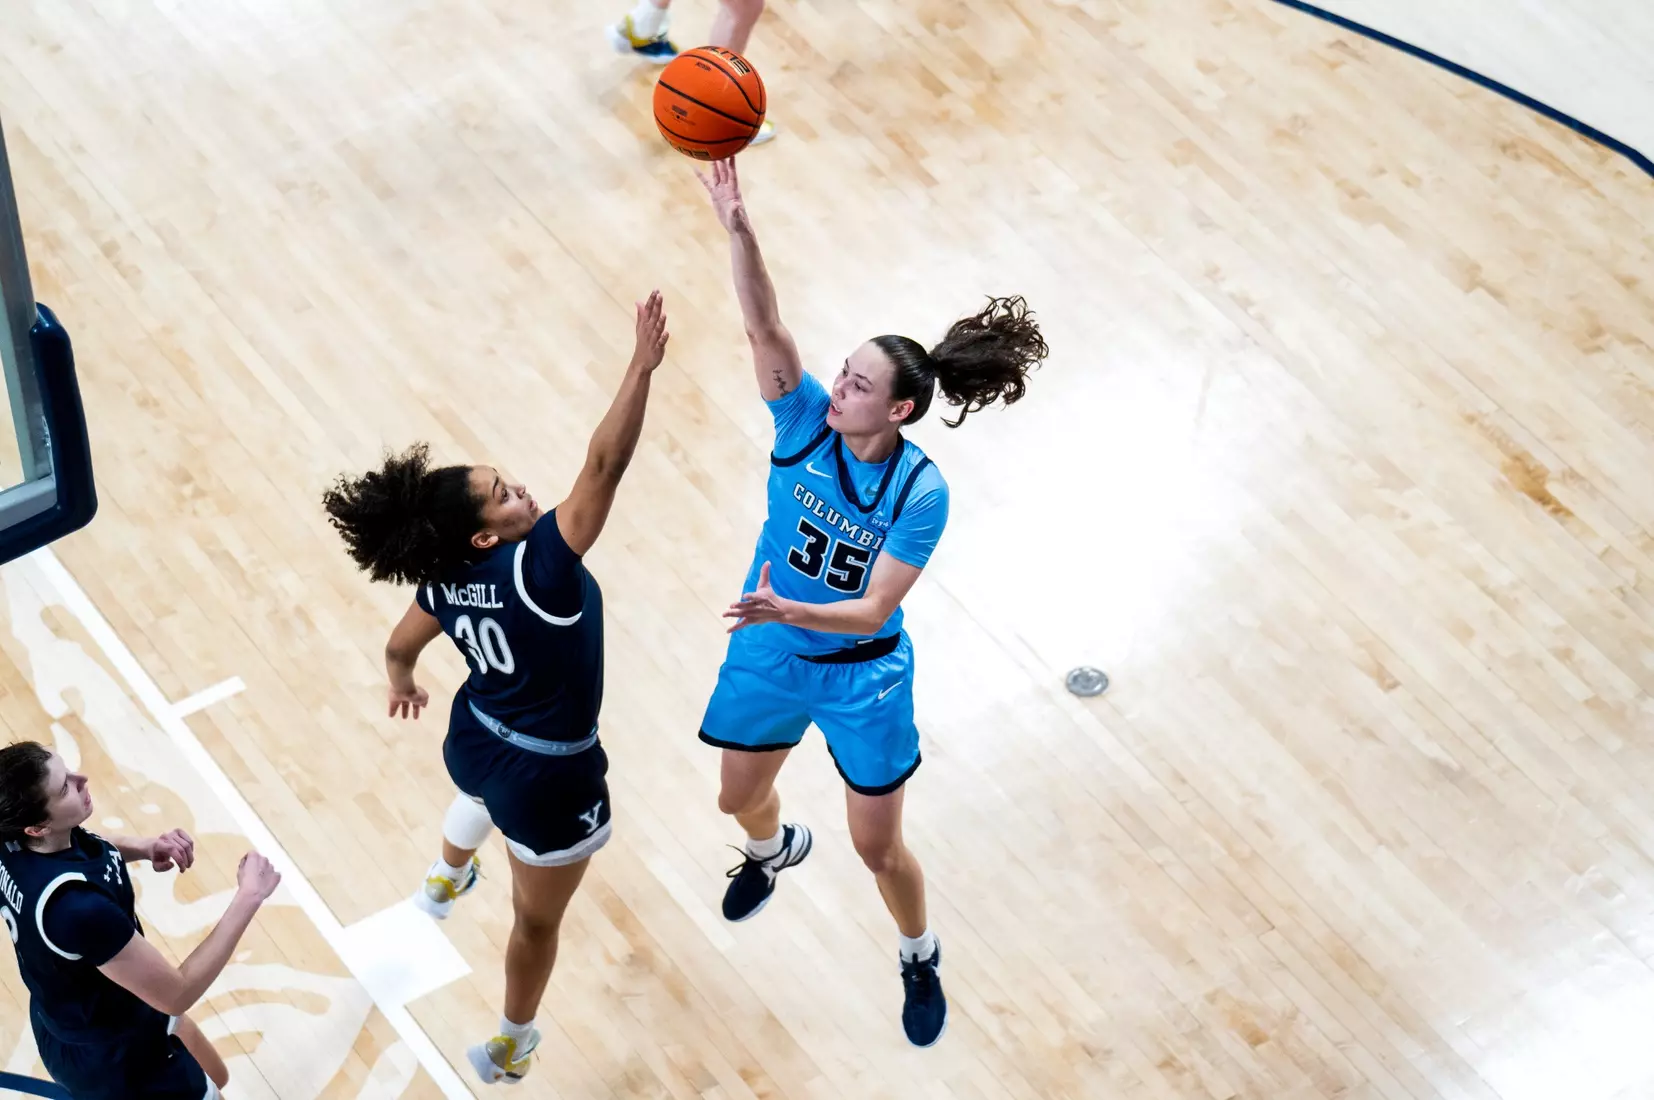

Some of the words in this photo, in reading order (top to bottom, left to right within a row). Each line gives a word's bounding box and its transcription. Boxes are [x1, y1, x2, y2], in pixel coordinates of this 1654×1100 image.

[793, 483, 884, 550] COLUMBI
[787, 516, 872, 593] 35
[455, 614, 515, 674] 30
[579, 801, 602, 834] Y
[0, 859, 23, 914] ONALD
